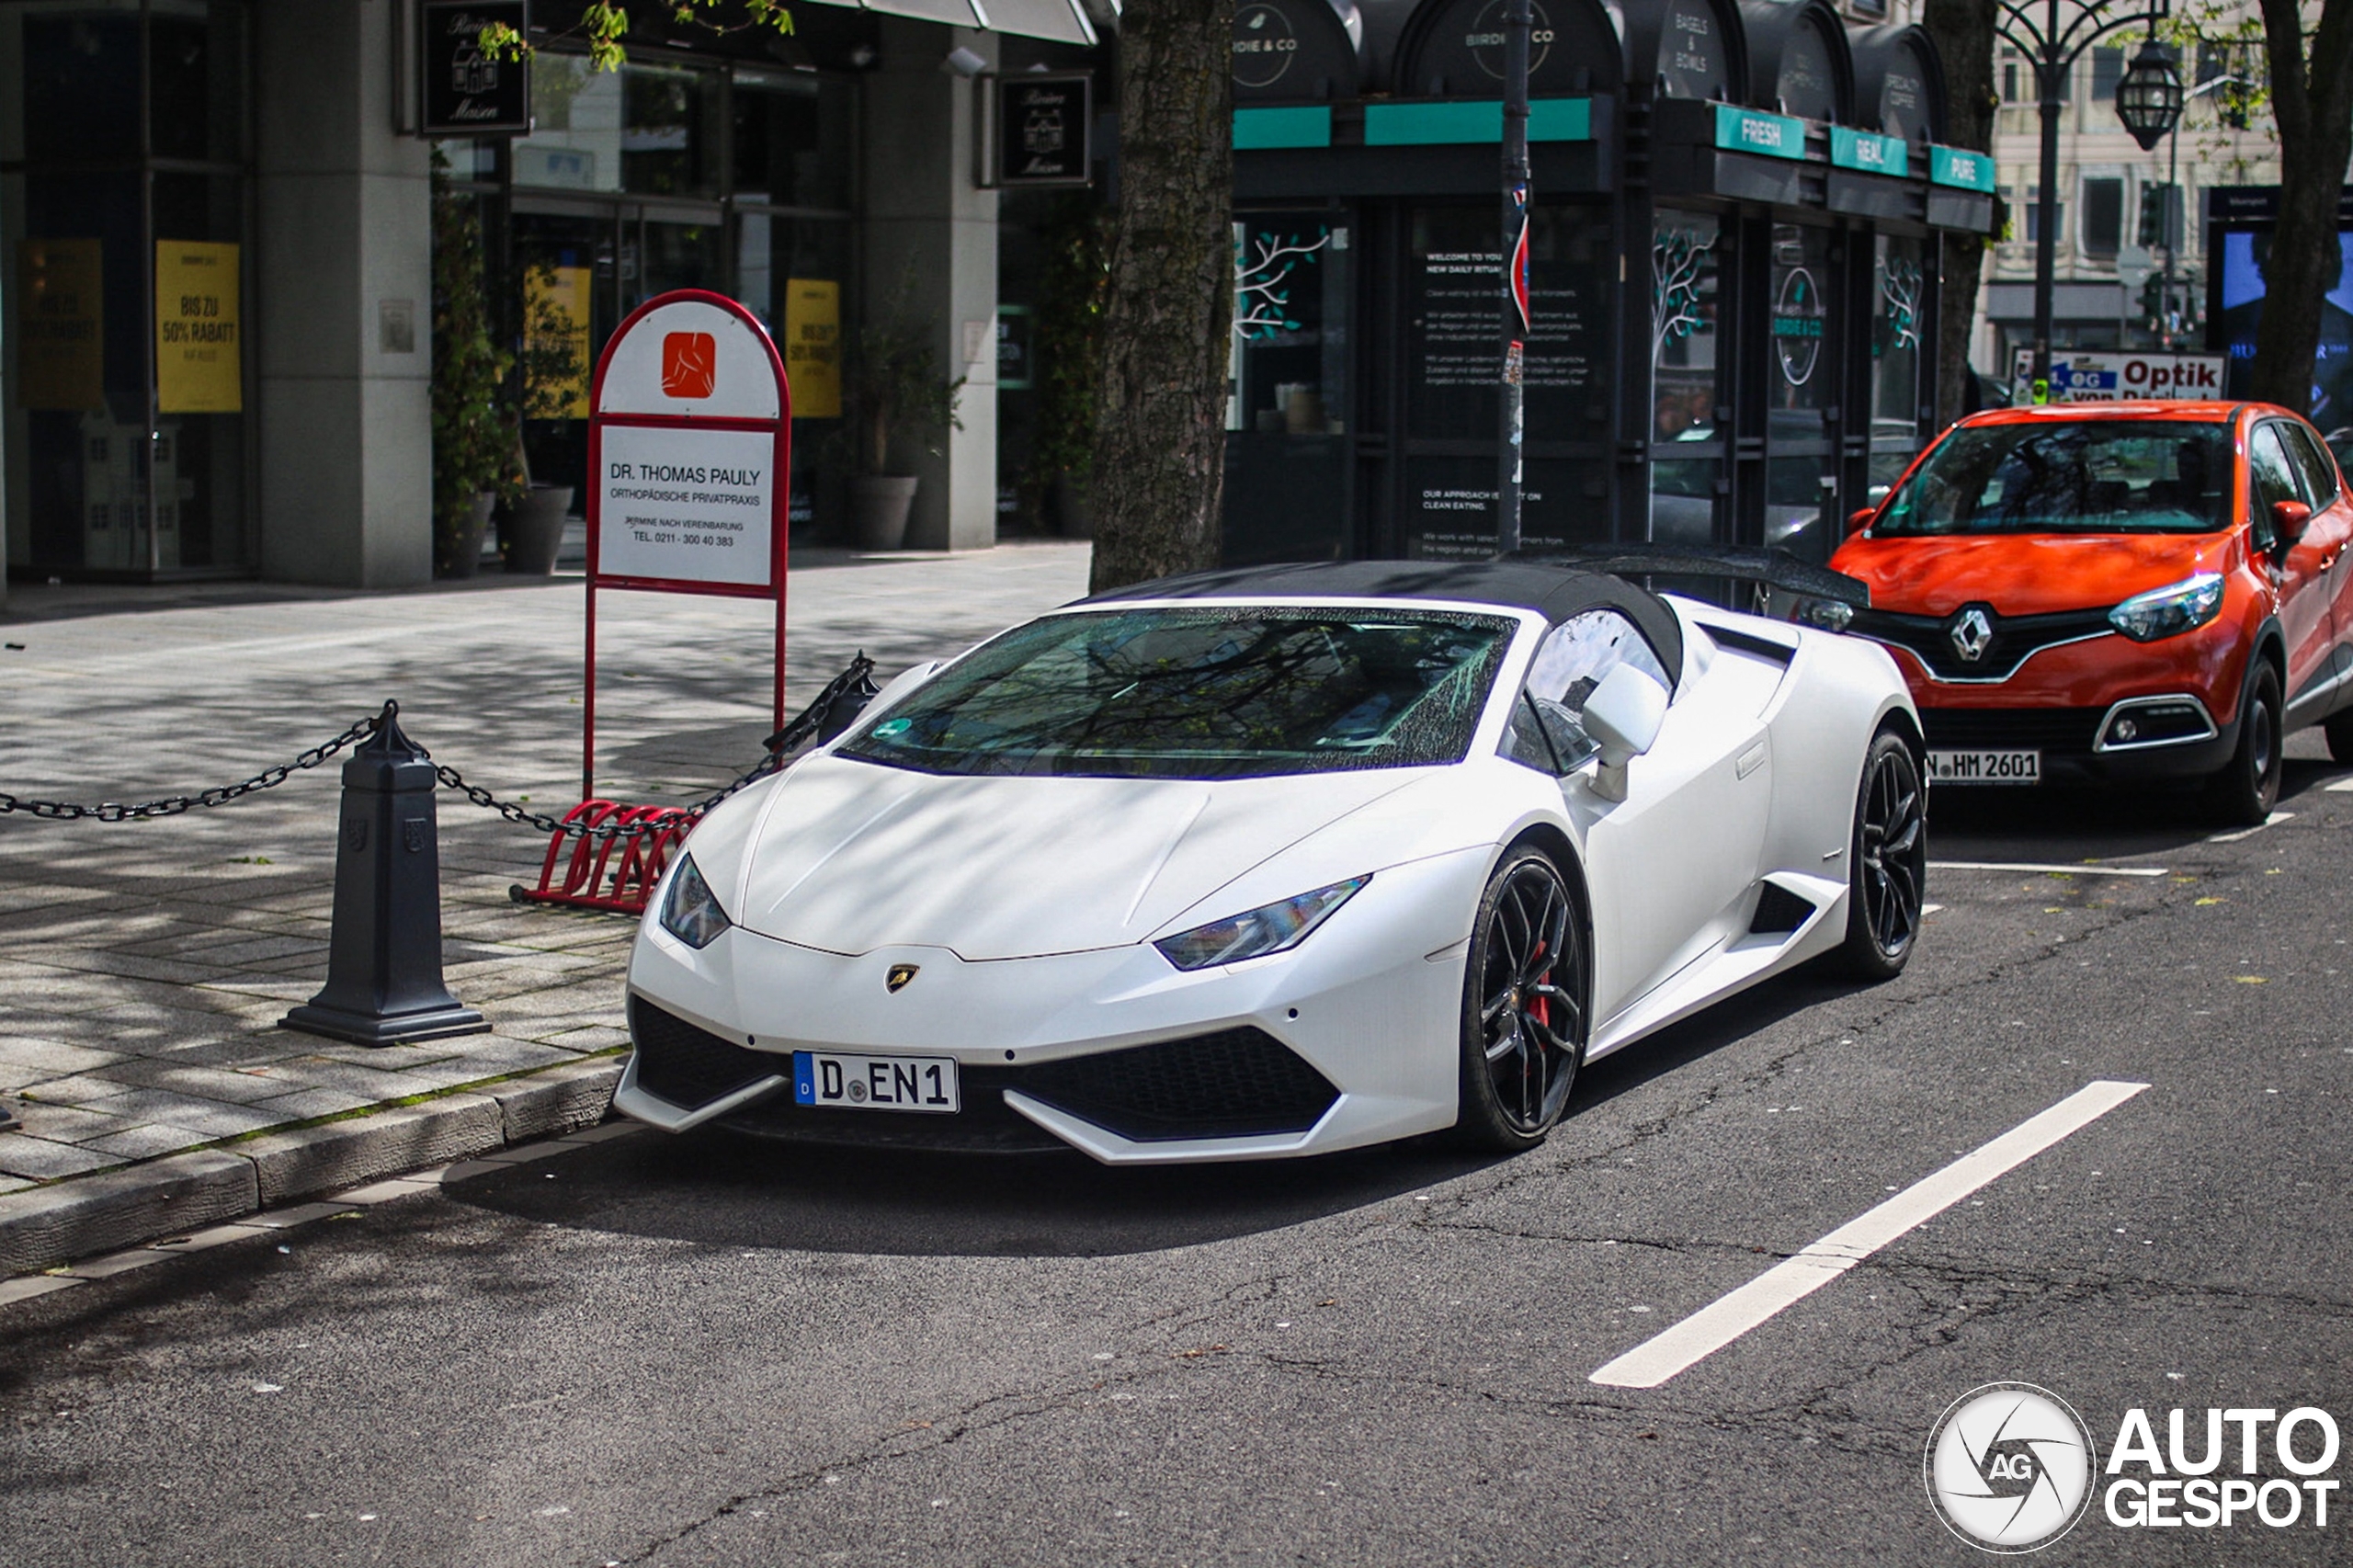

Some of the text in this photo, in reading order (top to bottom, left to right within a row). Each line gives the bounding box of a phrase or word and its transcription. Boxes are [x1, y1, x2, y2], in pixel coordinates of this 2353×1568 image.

[1465, 33, 1506, 47] BIRDI
[1742, 118, 1781, 147] FRESH
[1856, 139, 1884, 165] REAL
[1950, 157, 1976, 181] PURE
[1427, 253, 1469, 262] WELCOME
[1472, 253, 1483, 262] TO
[1427, 266, 1447, 274] NEW
[1449, 266, 1472, 274] DAILY
[180, 296, 219, 317] BIS ZU
[163, 323, 235, 343] 50% RABATT
[2070, 371, 2101, 388] OG
[2124, 360, 2218, 390] Optik
[610, 463, 761, 486] DR. THOMAS PAULY
[610, 487, 761, 506] ORTHOPÄDISCHE PRIVATPRAXIS
[1423, 490, 1442, 498] OUR
[1444, 491, 1490, 500] APPROACH
[1422, 501, 1451, 509] CLEAN
[659, 518, 681, 528] NACH
[682, 519, 745, 532] VEREINBARUNG
[634, 530, 654, 542] TEL.
[654, 532, 676, 544] 0211
[683, 533, 700, 545] 300
[702, 535, 714, 546] 40
[716, 536, 733, 548] 383
[1953, 754, 1980, 777] HM
[1985, 754, 2037, 778] 2601
[801, 1083, 810, 1096] D
[820, 1060, 844, 1100] D
